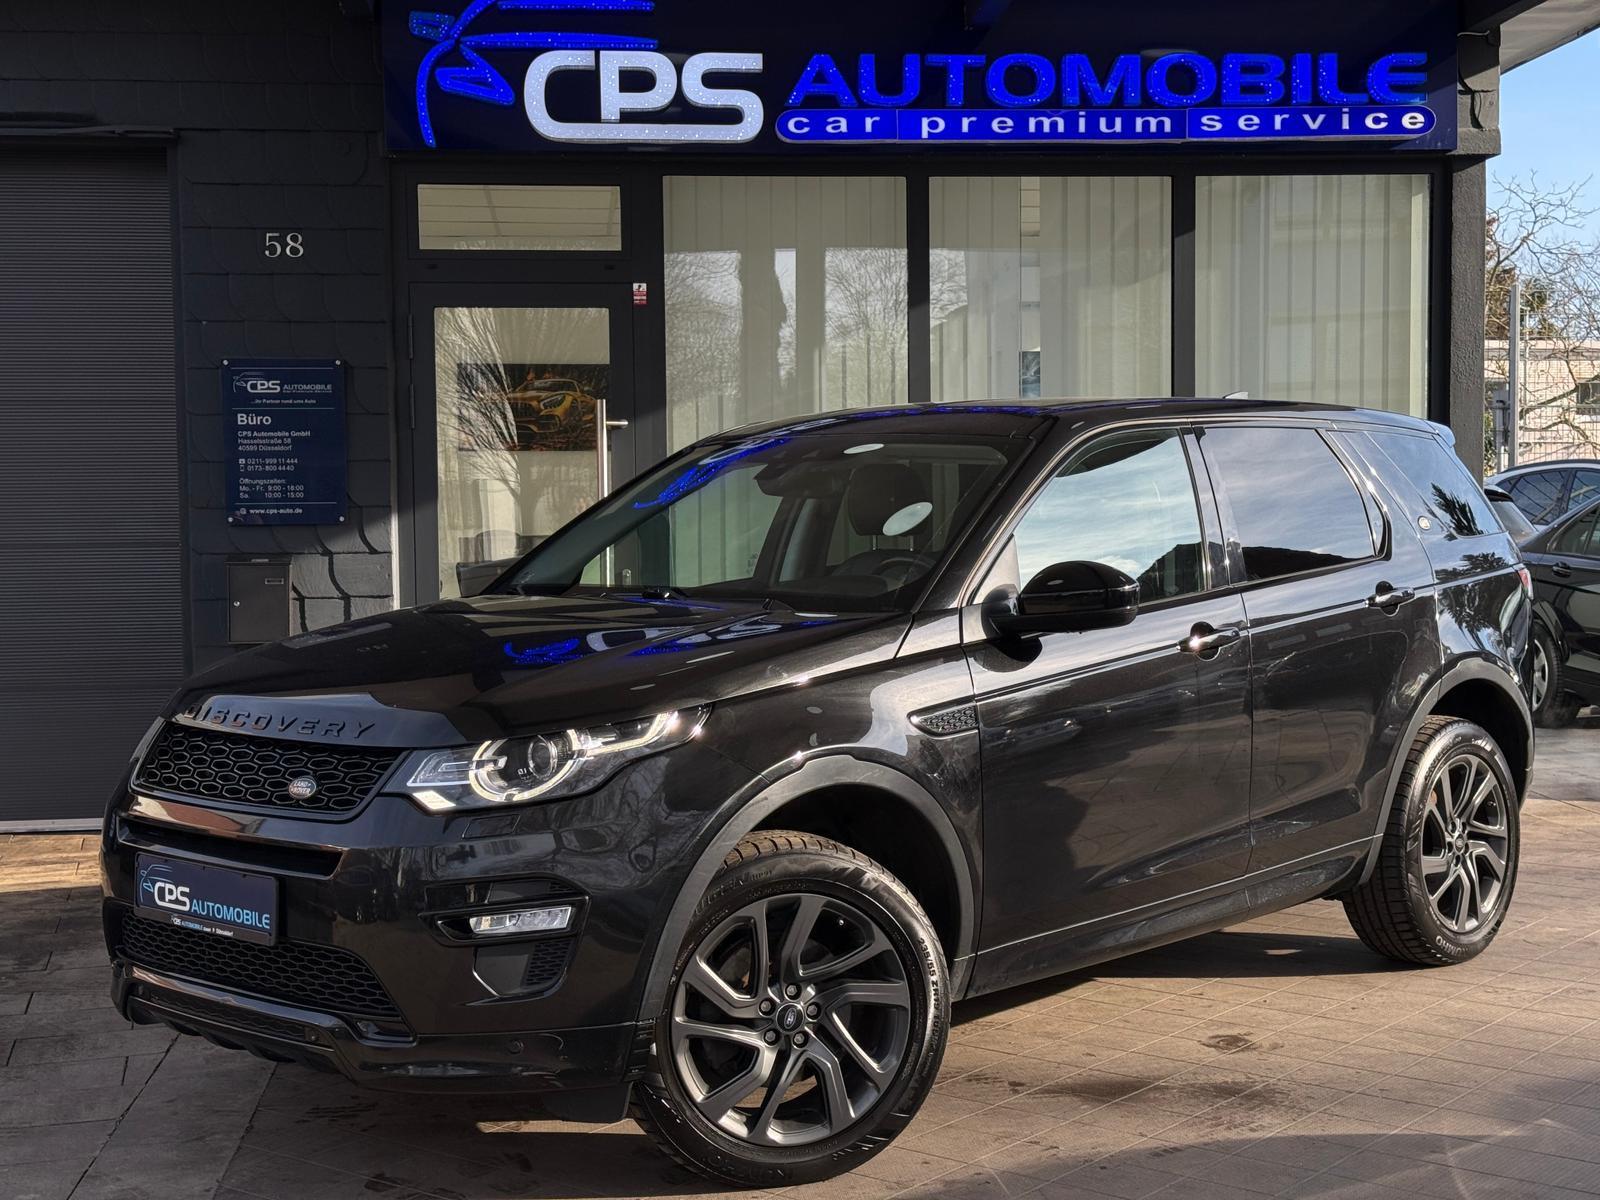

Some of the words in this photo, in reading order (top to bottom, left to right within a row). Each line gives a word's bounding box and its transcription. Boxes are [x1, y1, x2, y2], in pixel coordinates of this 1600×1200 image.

[523, 50, 764, 144] CPS
[784, 52, 1428, 107] AUTOMOBILE
[787, 115, 880, 135] car
[921, 112, 1172, 139] premium
[1200, 106, 1425, 132] service
[264, 232, 304, 257] 58
[246, 380, 281, 393] CPS
[282, 383, 332, 391] AUTOMOBILE
[237, 413, 272, 425] Büro
[249, 507, 303, 515] www.cps-auto.de
[183, 703, 376, 739] DISCOVERY
[292, 785, 311, 795] ROVER
[153, 881, 191, 912] CPS
[191, 899, 271, 930] AUTOMOBILE
